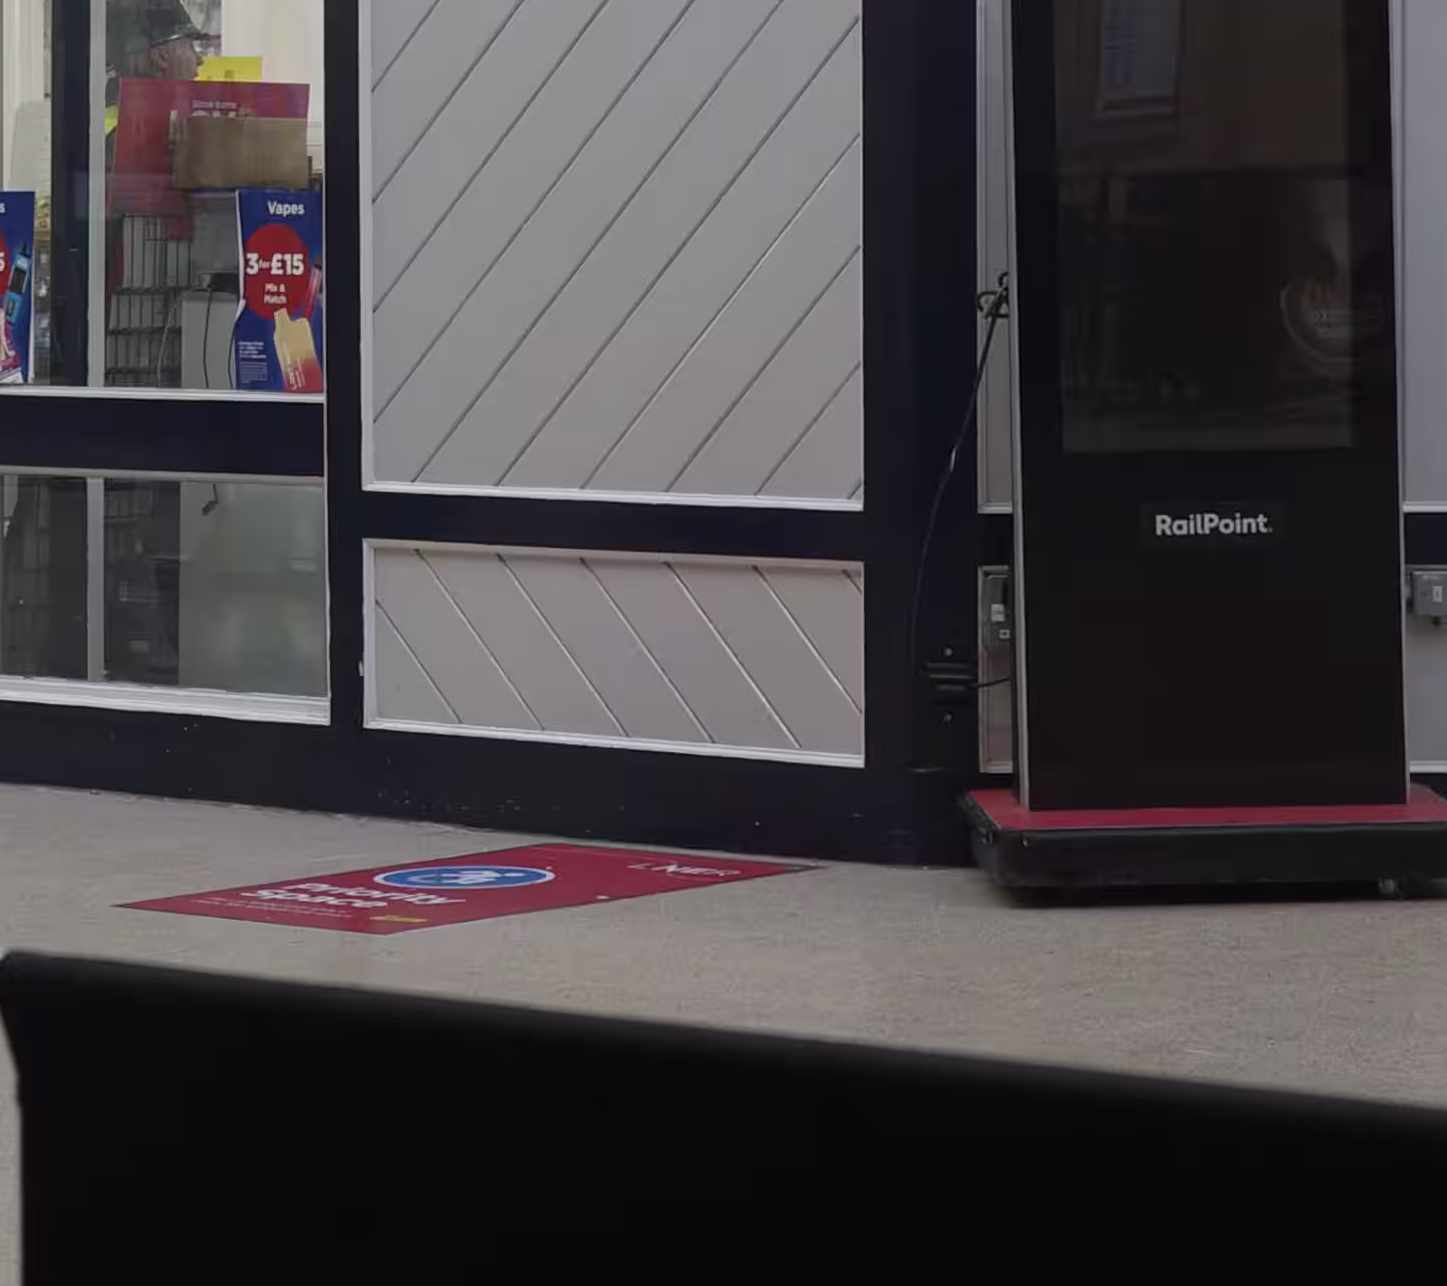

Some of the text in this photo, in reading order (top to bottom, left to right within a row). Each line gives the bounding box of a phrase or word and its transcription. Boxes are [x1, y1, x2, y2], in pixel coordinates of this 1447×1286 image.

[267, 201, 305, 217] Vapes
[245, 253, 259, 276] 3
[271, 253, 305, 276] £15
[627, 861, 742, 878] LNER
[241, 888, 390, 909] Space
[283, 881, 467, 906] Priority
